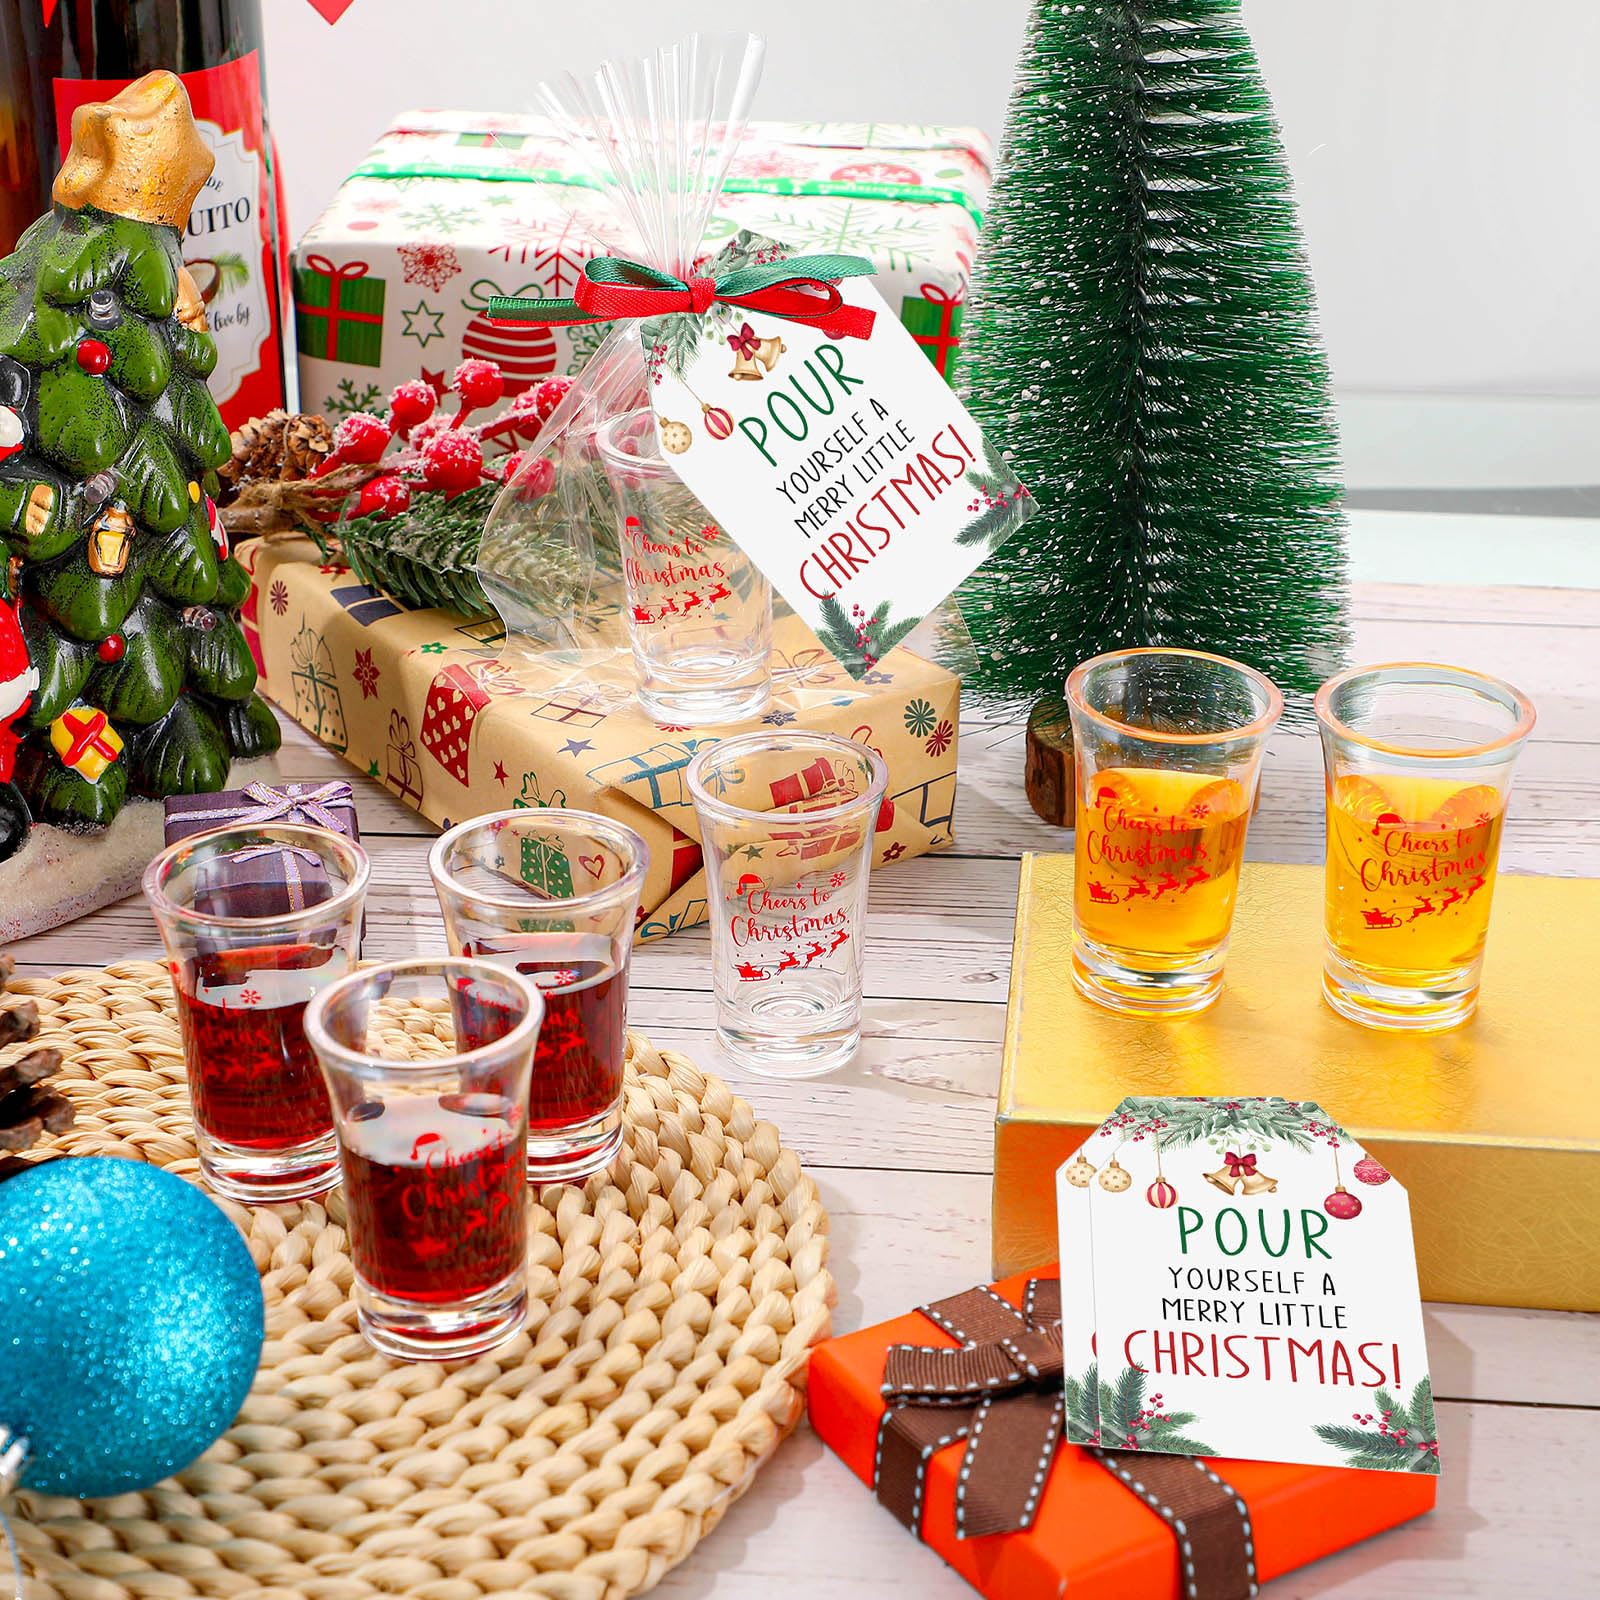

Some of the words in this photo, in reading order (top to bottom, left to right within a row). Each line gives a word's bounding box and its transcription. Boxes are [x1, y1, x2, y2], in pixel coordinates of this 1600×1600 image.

[186, 196, 251, 237] UITO
[738, 344, 864, 468] POUR
[776, 411, 869, 505] YOURSELF
[869, 398, 890, 421] A
[794, 474, 855, 539] MERRY
[852, 419, 916, 485] LITTLE
[800, 423, 977, 600] CHRISTMAS!
[632, 533, 681, 558] Cheers
[683, 536, 704, 555] to
[626, 558, 727, 590] Christmas
[1103, 805, 1163, 837] Cheers
[1168, 815, 1190, 835] to
[1087, 830, 1209, 868] Christmas
[1384, 831, 1450, 857] Cheers
[1361, 851, 1488, 892] Christmas
[747, 890, 809, 915] Cheers
[809, 887, 832, 906] to
[731, 906, 849, 947] Christmas
[1178, 1206, 1332, 1260] POUR
[1168, 1266, 1305, 1295] YOURSELF
[1322, 1273, 1337, 1297] A
[1161, 1298, 1246, 1323] MERRY
[1259, 1302, 1349, 1329] LITTLE
[1124, 1330, 1402, 1389] CHRISTMAS!
